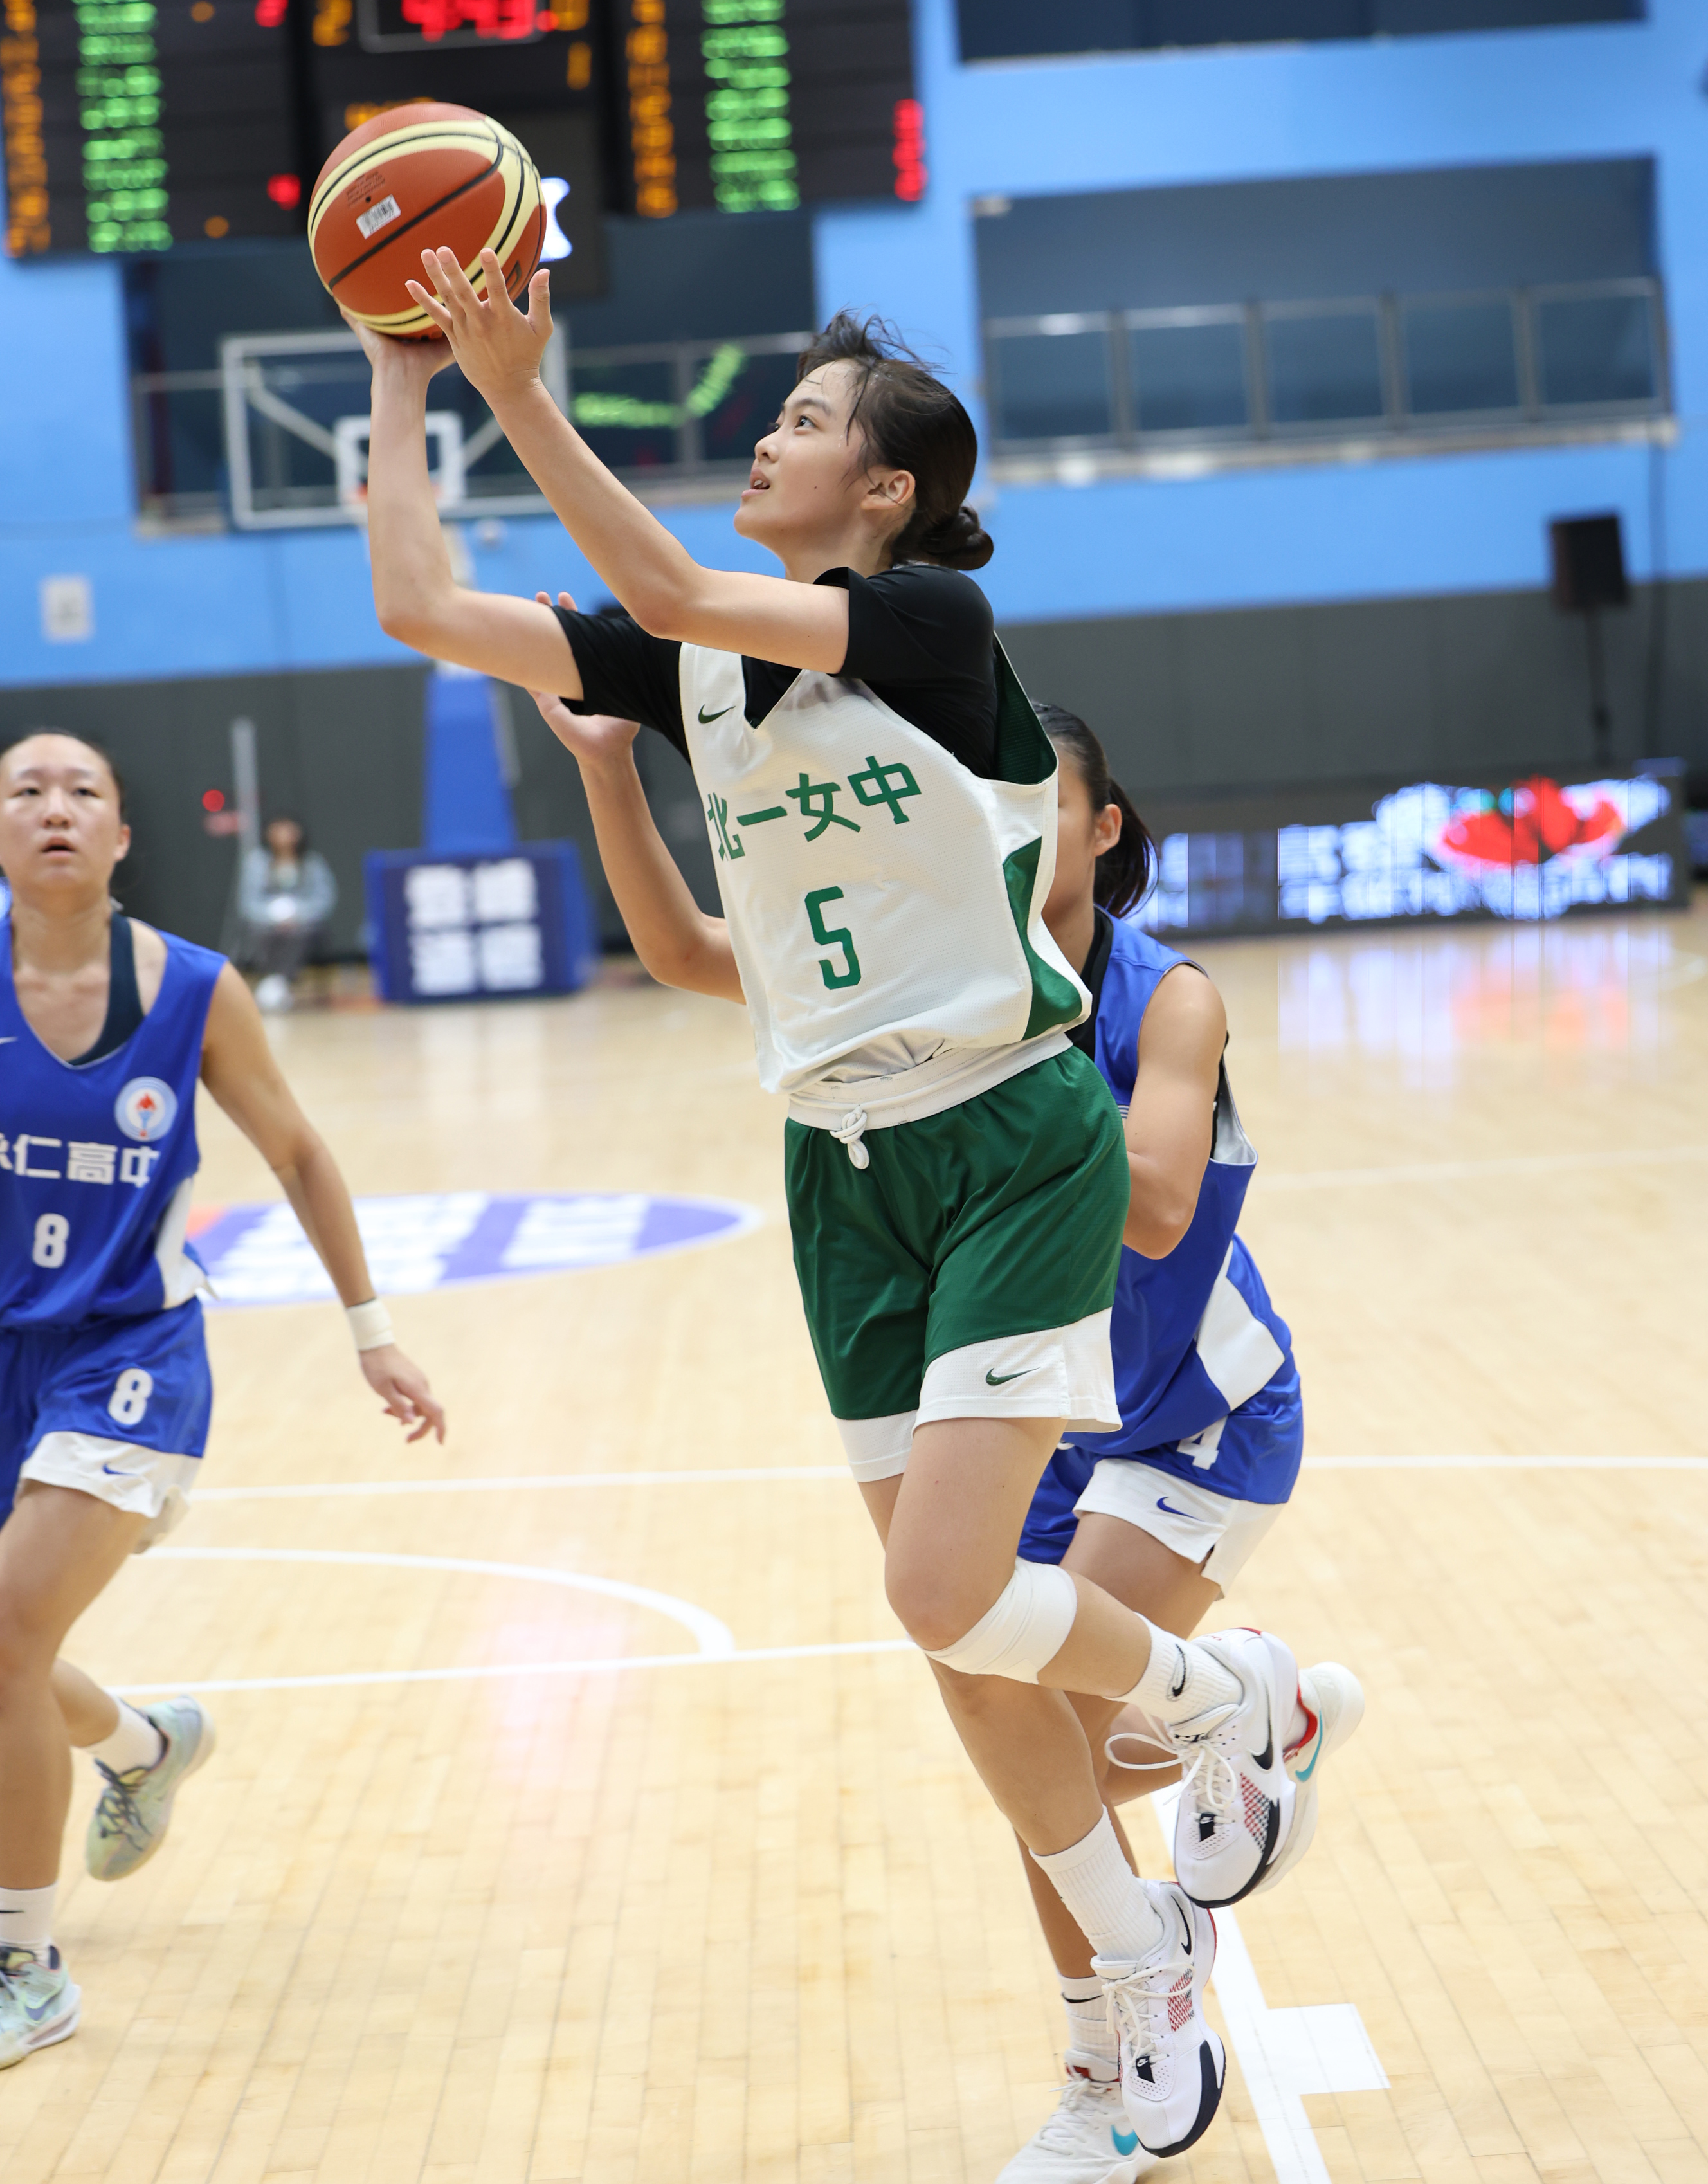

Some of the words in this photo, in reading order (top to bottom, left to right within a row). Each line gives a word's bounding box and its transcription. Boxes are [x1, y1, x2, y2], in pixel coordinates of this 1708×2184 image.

[707, 755, 922, 861] 北一女中
[804, 886, 861, 990] 5
[33, 1213, 69, 1269] 8
[108, 1367, 154, 1425] 8
[1176, 1414, 1228, 1471] 4
